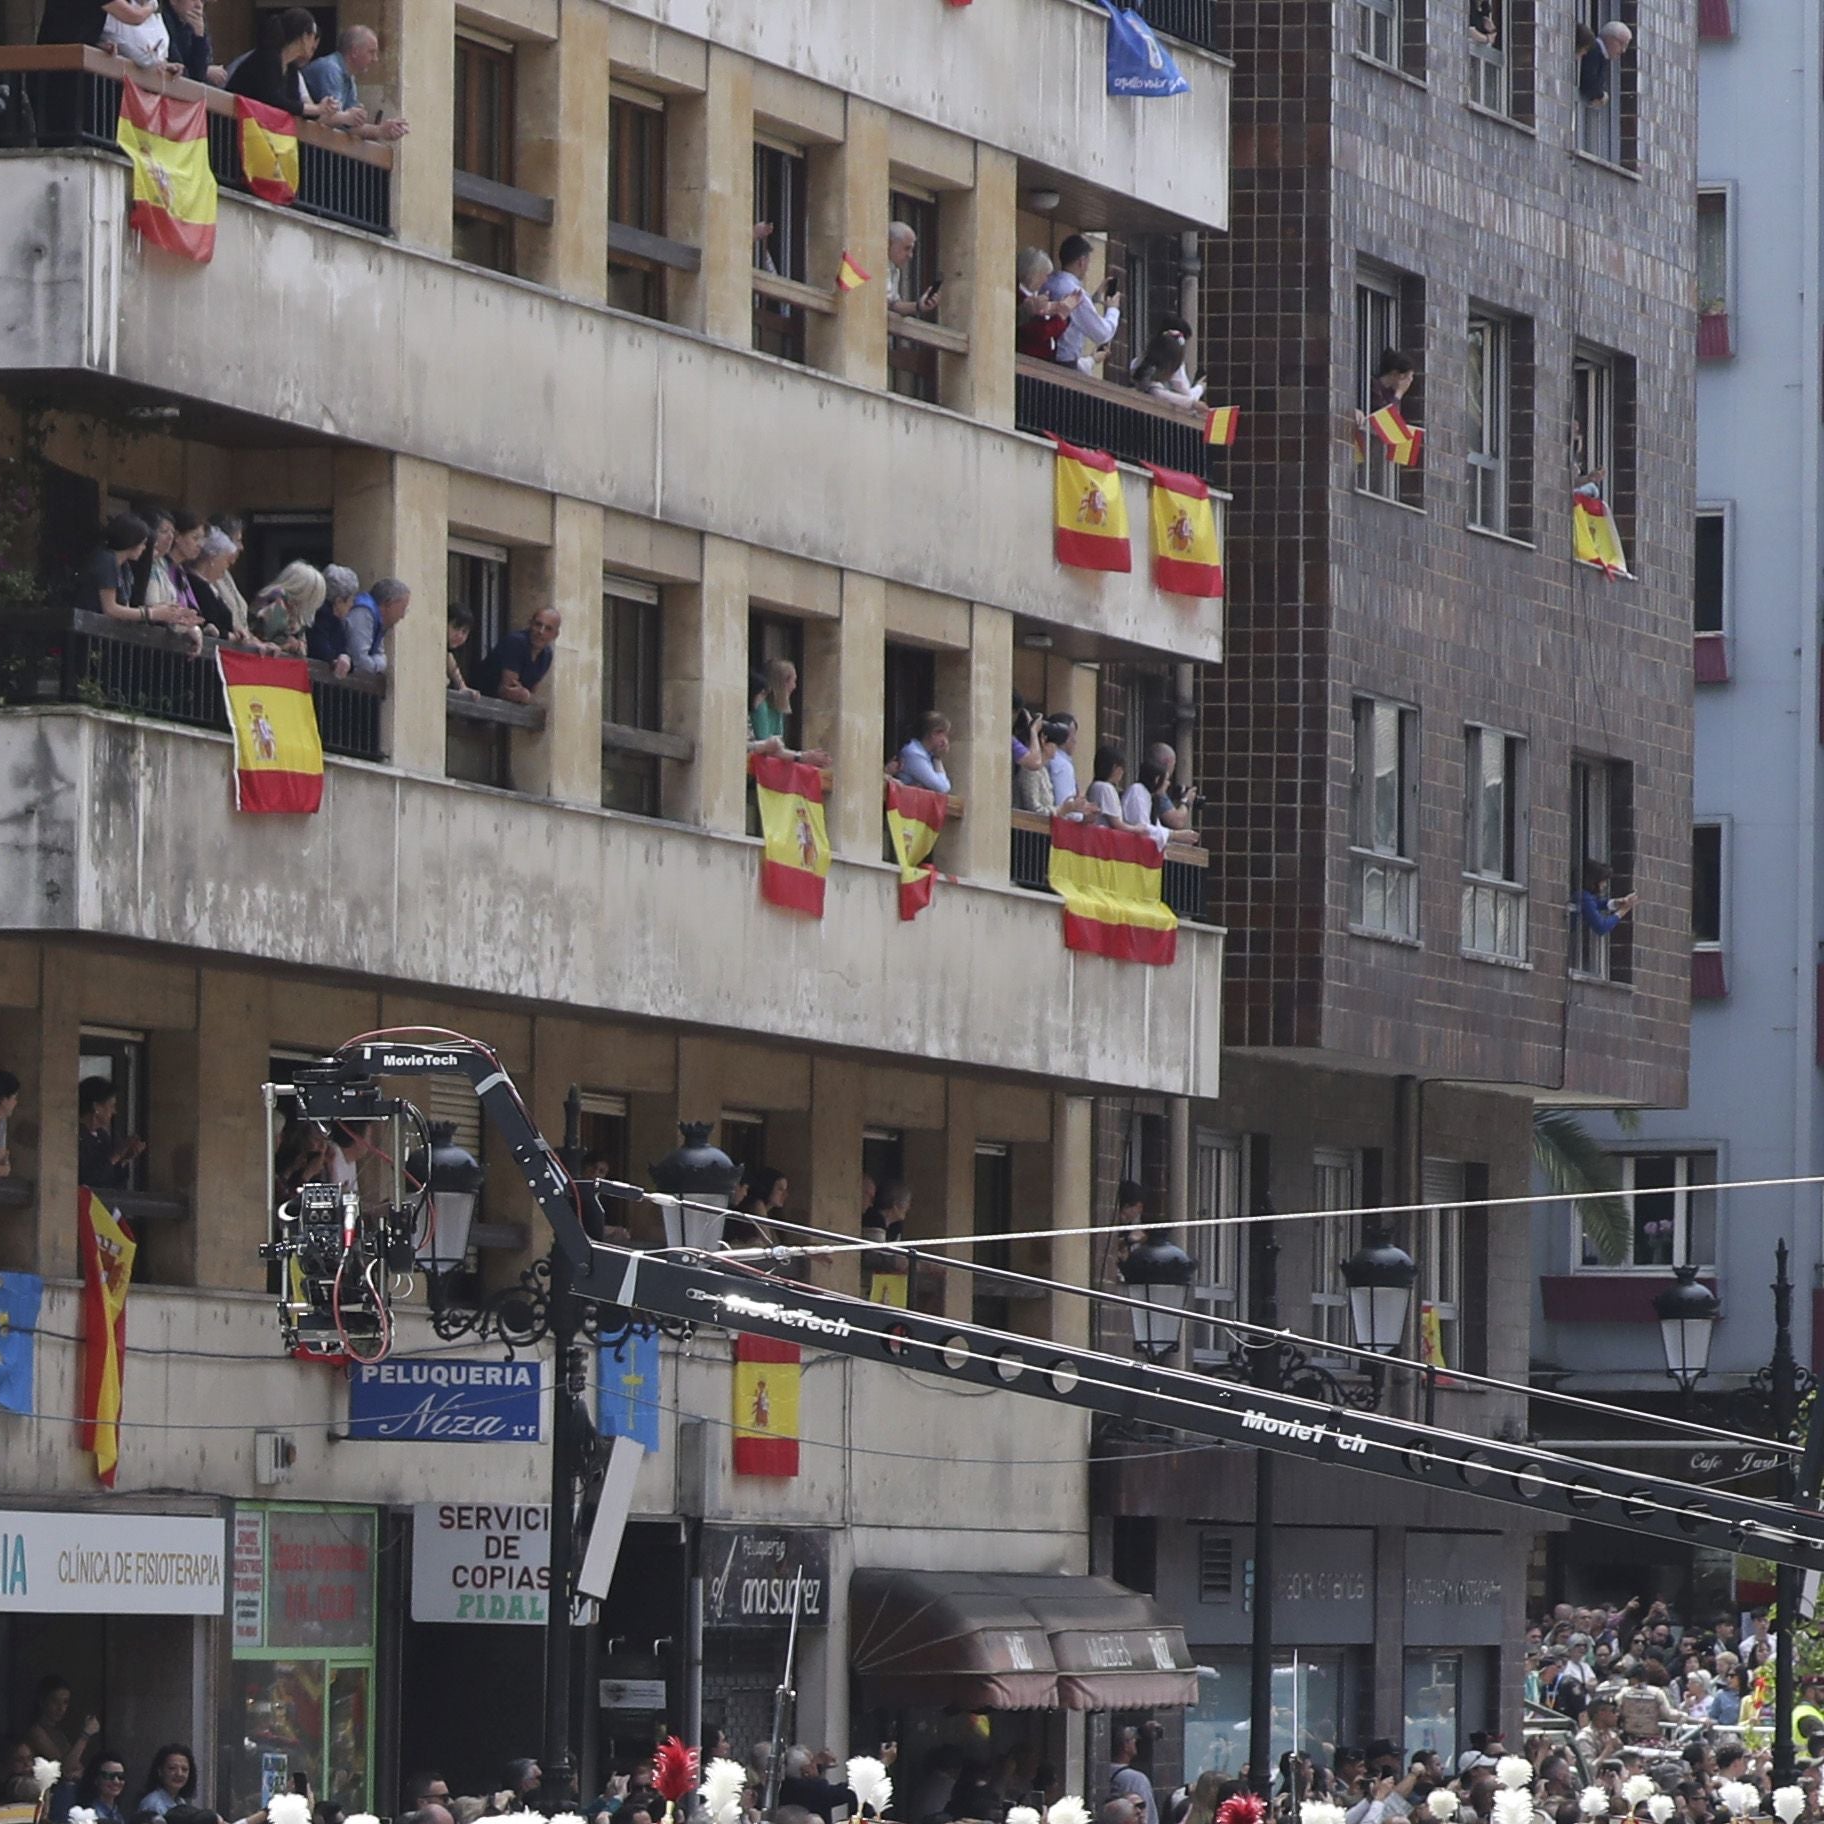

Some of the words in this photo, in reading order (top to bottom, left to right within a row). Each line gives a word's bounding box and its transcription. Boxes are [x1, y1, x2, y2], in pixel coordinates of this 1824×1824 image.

[383, 1054, 458, 1067] MovieTech
[361, 1364, 532, 1387] PELUQUERIA
[378, 1391, 507, 1436] Niza
[528, 1424, 536, 1437] F
[1241, 1408, 1368, 1454] MovieTch
[438, 1505, 549, 1531] SERVICI
[484, 1535, 521, 1560] DE
[58, 1543, 111, 1584] CLÍNICA
[114, 1551, 132, 1584] DE
[136, 1551, 221, 1586] FISIOTERAPIA
[452, 1565, 551, 1590] COPIAS
[455, 1594, 545, 1620] PIDAL
